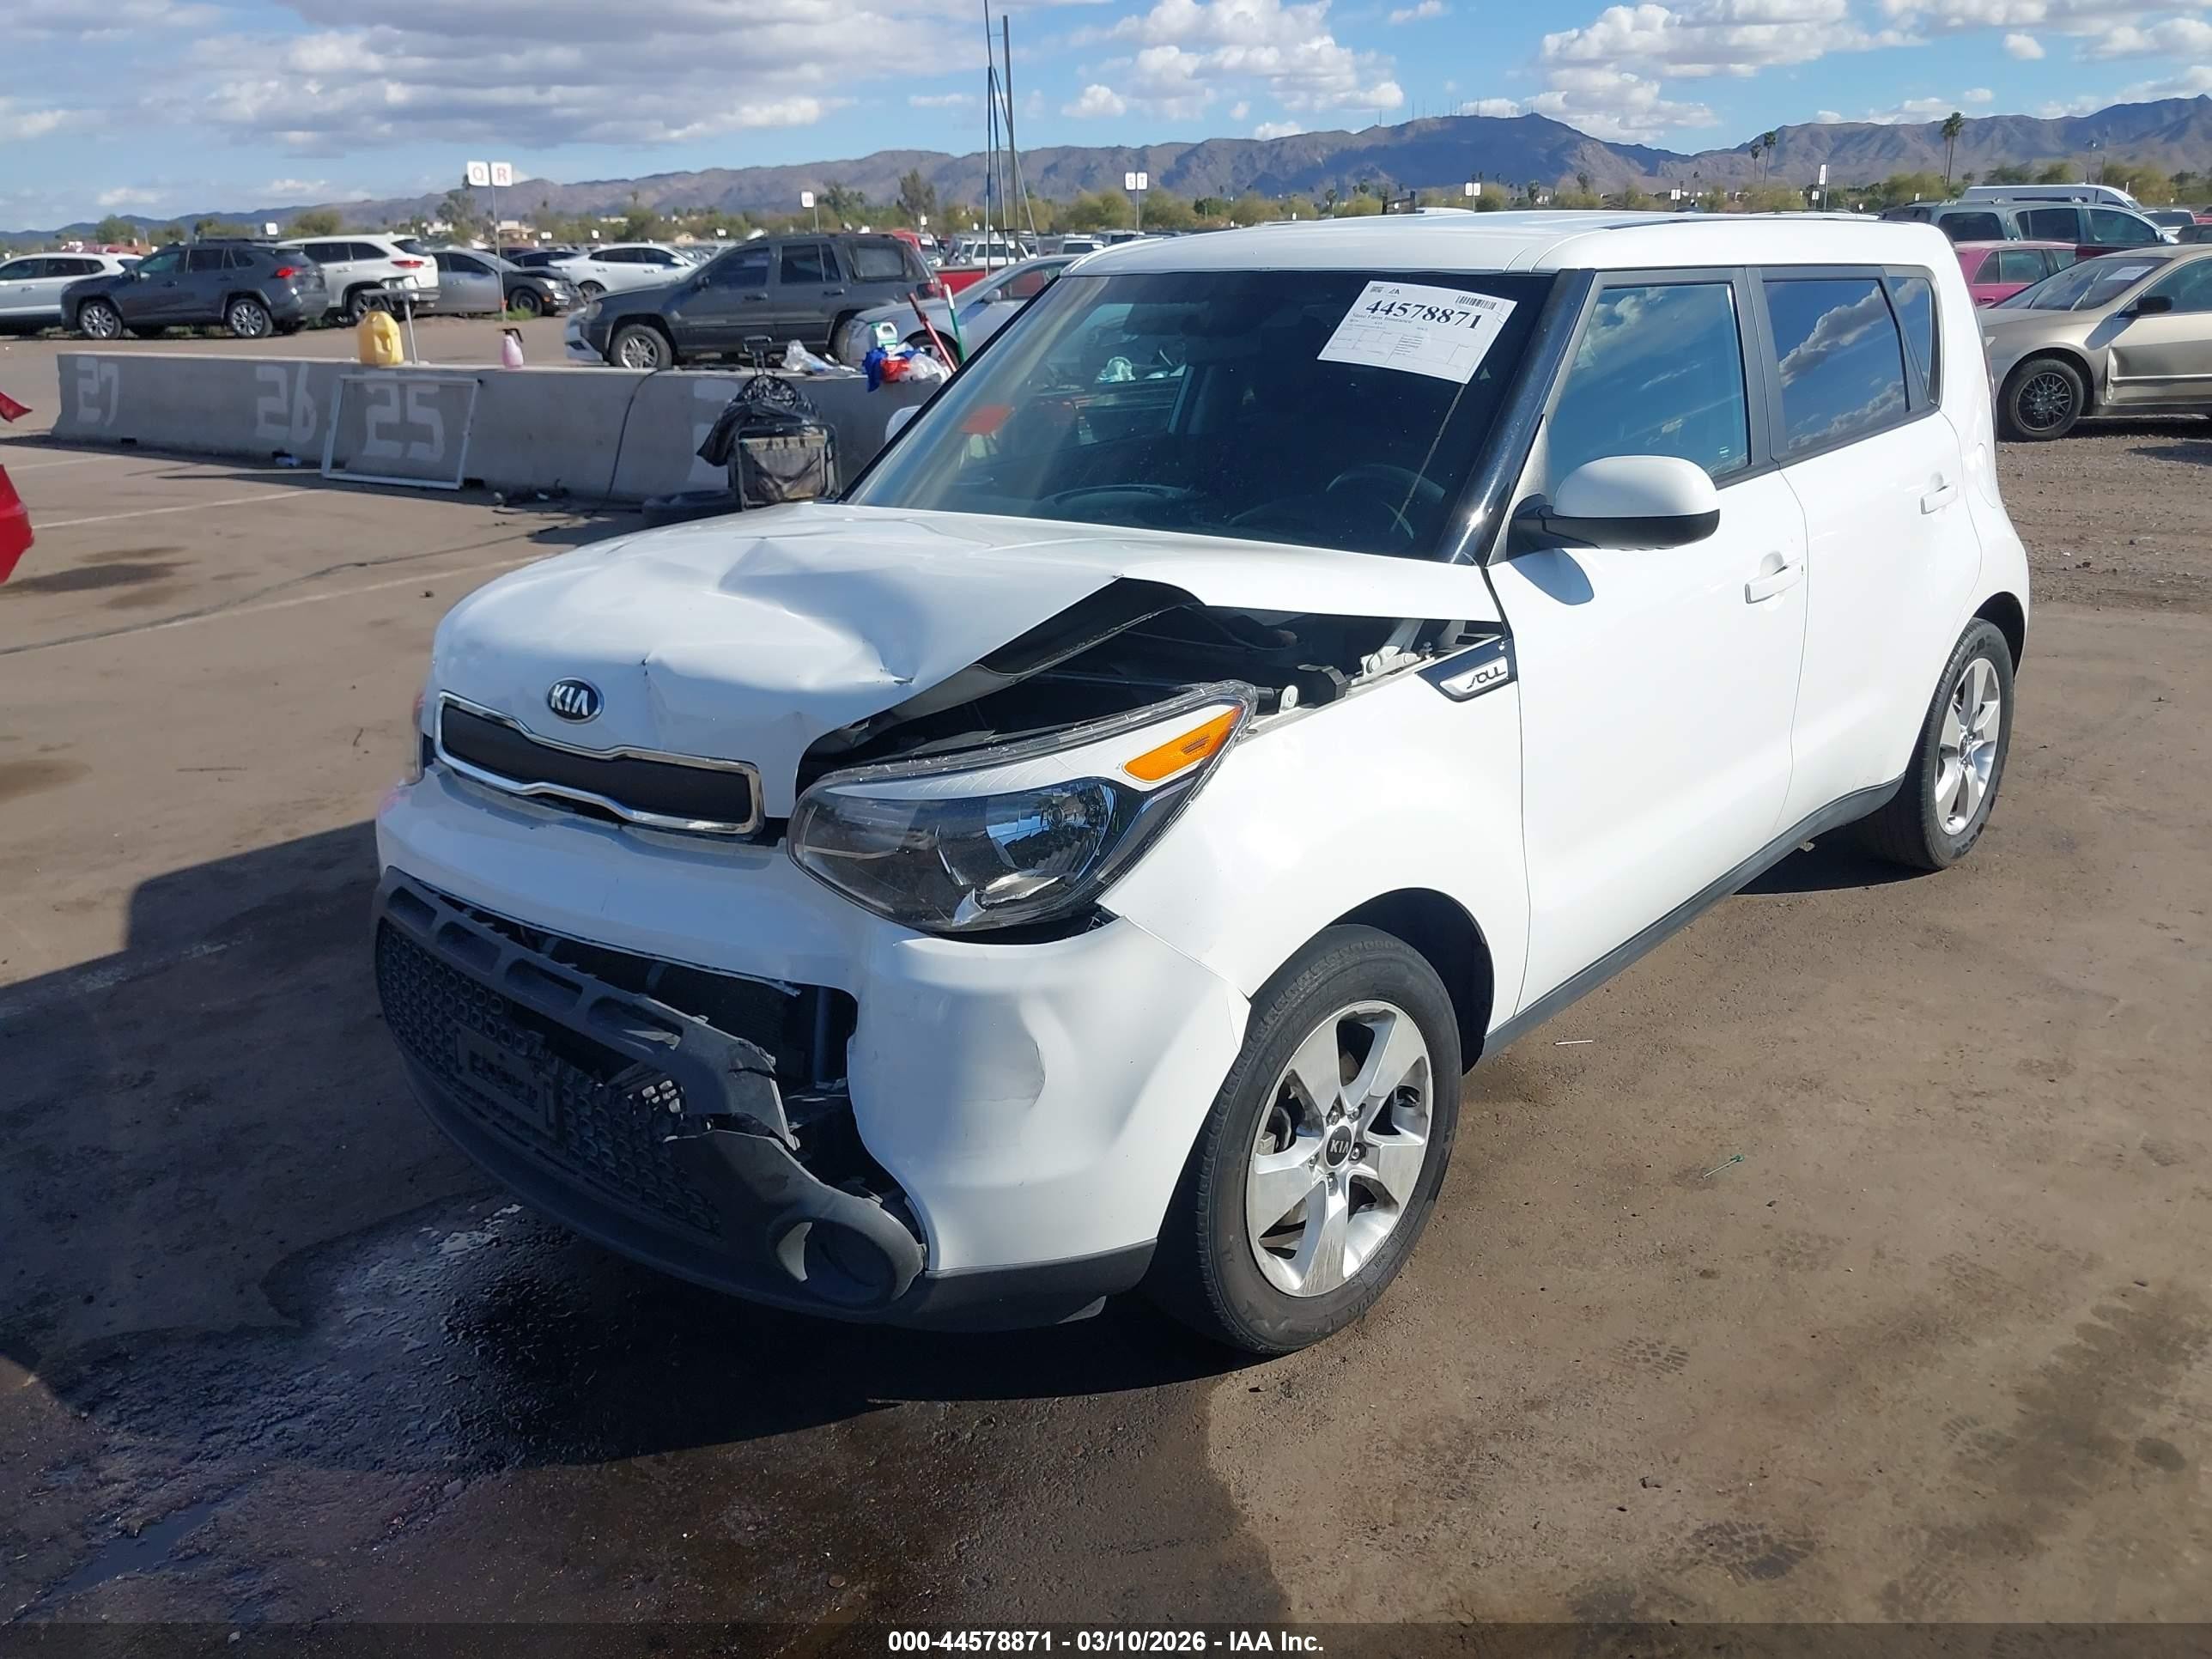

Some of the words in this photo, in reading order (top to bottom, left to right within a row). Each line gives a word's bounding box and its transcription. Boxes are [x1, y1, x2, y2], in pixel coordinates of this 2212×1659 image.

[471, 167, 484, 180] Q
[497, 168, 507, 181] R
[1365, 299, 1483, 330] 44578871
[76, 356, 119, 427] 27
[255, 362, 317, 444] 26
[362, 371, 445, 463] 25
[1467, 666, 1506, 690] SOUL
[550, 684, 589, 716] KIA
[1330, 1139, 1349, 1153] KIA
